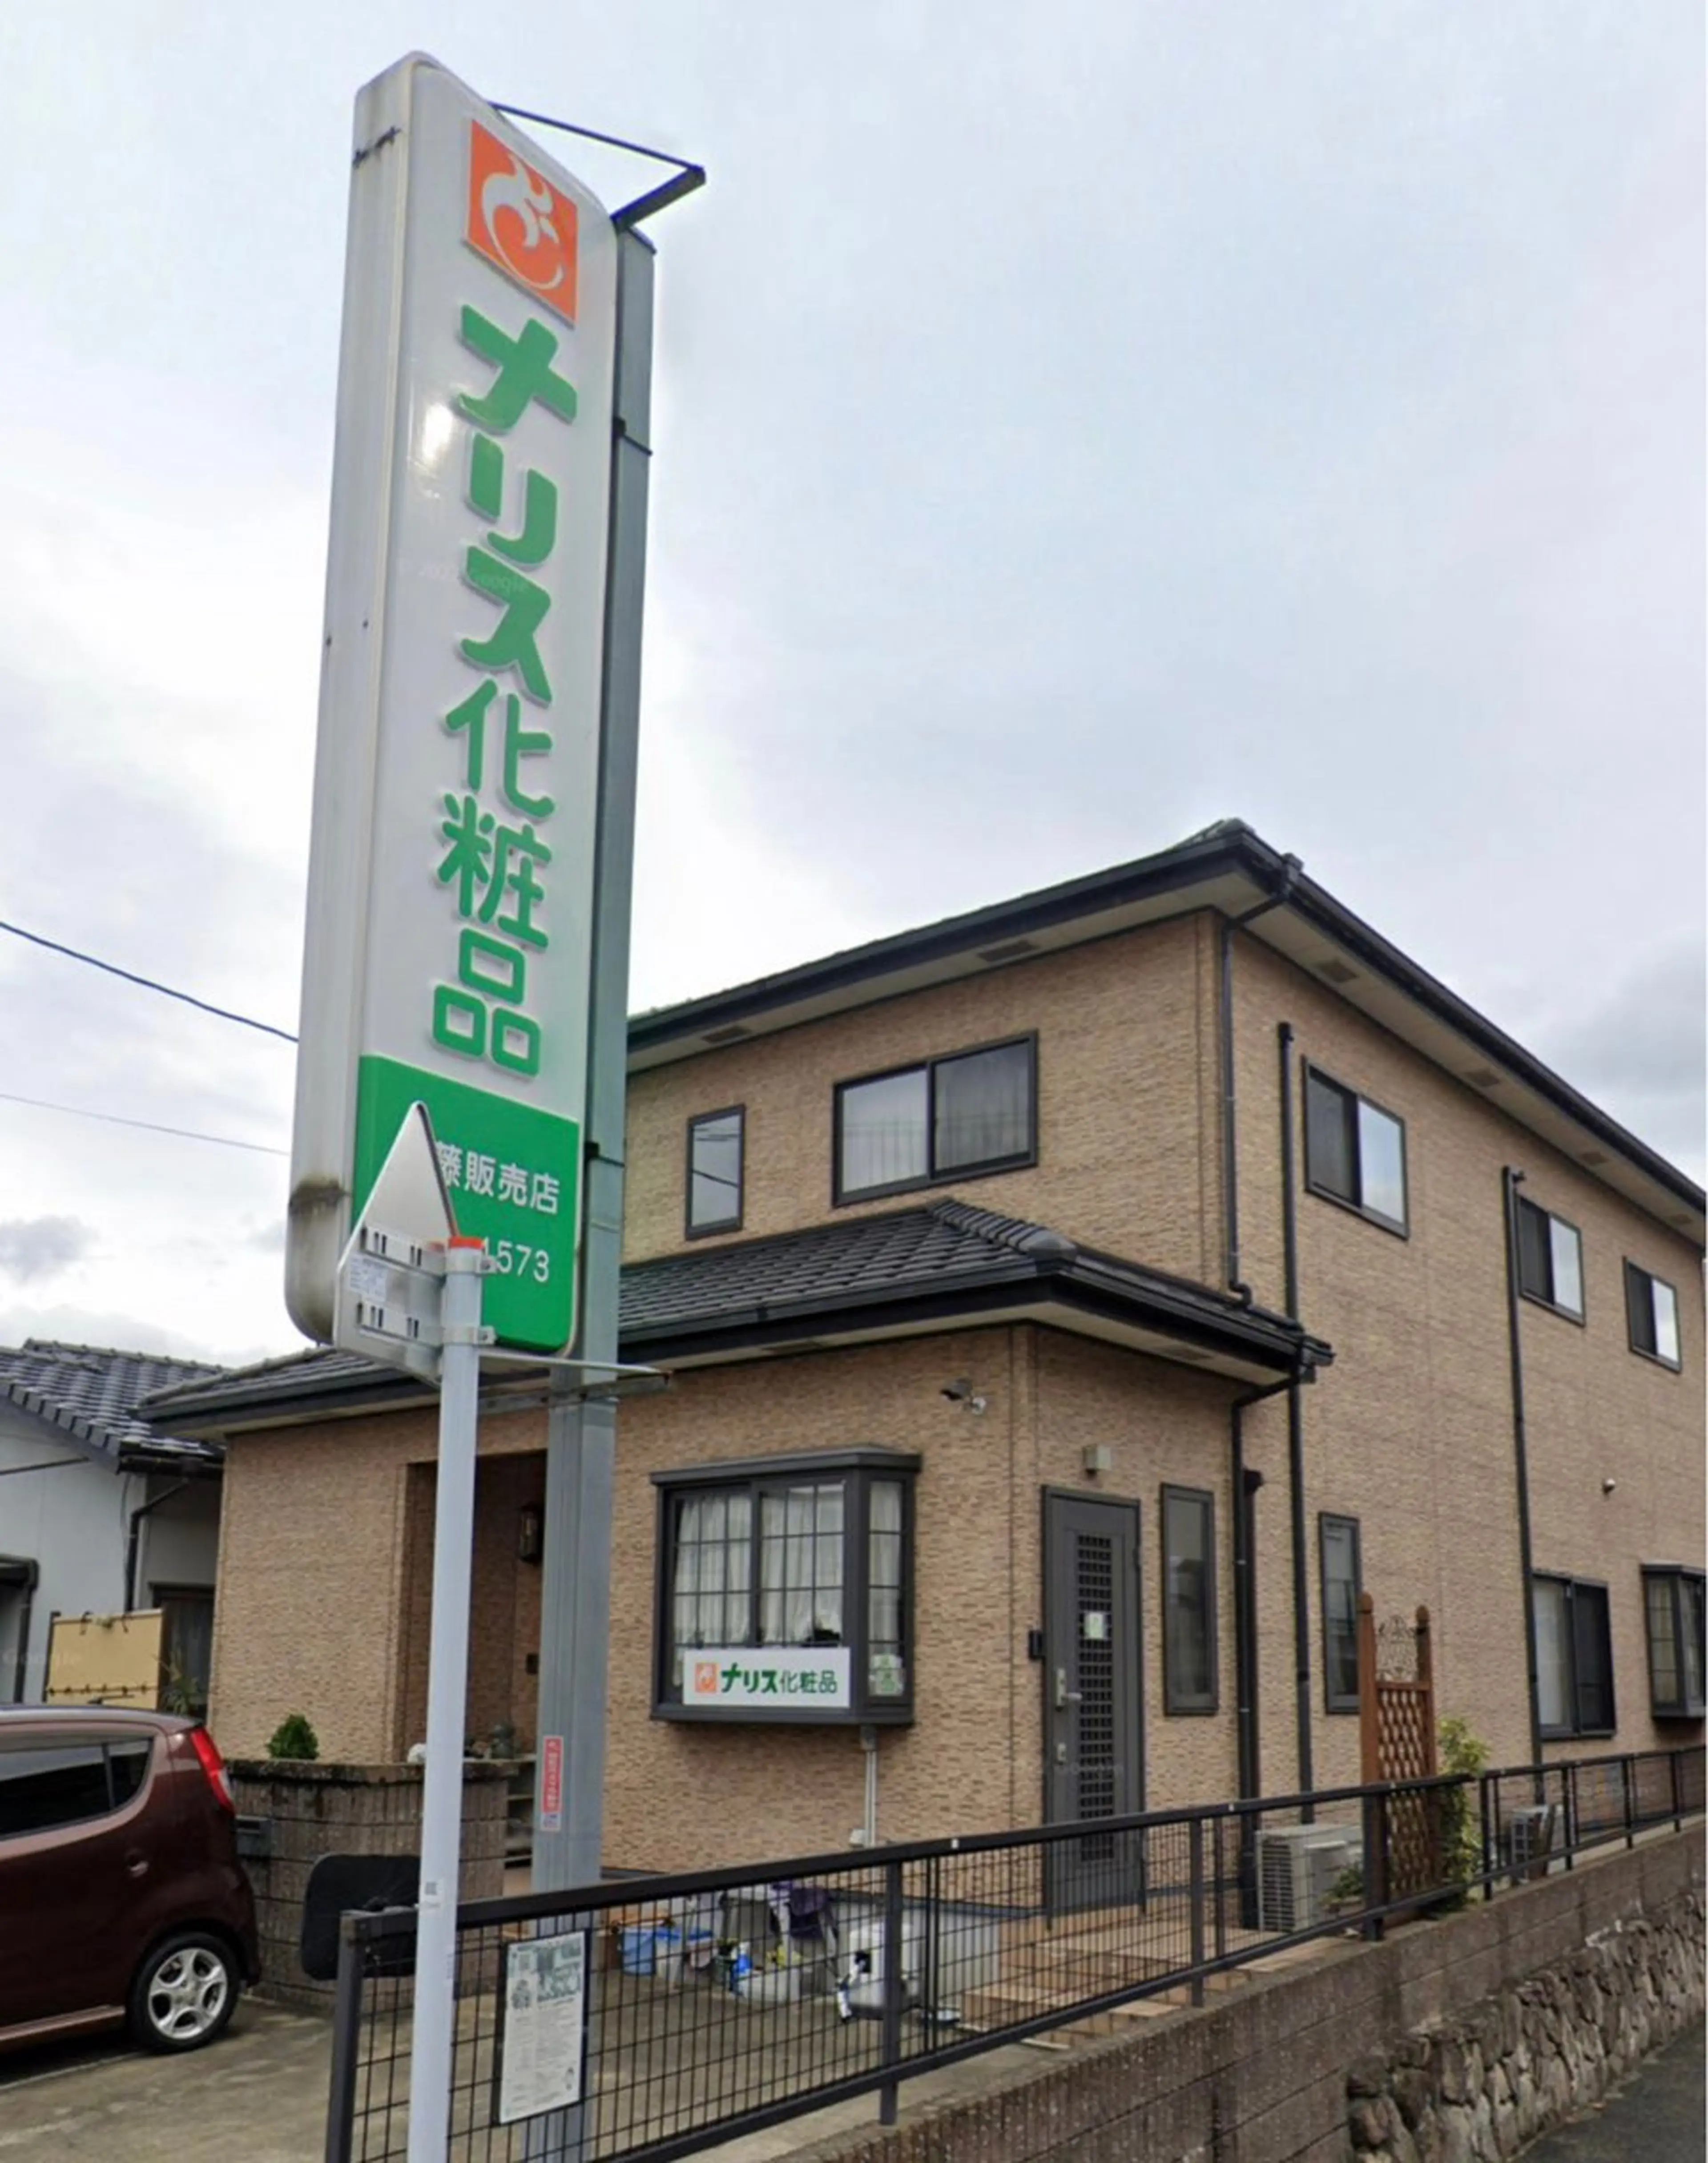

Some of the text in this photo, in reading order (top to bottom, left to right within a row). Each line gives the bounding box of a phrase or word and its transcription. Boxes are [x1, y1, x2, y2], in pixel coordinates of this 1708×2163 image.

[432, 304, 578, 1078] ナリス化粧品
[721, 1662, 838, 1693] ナリス化粧品
